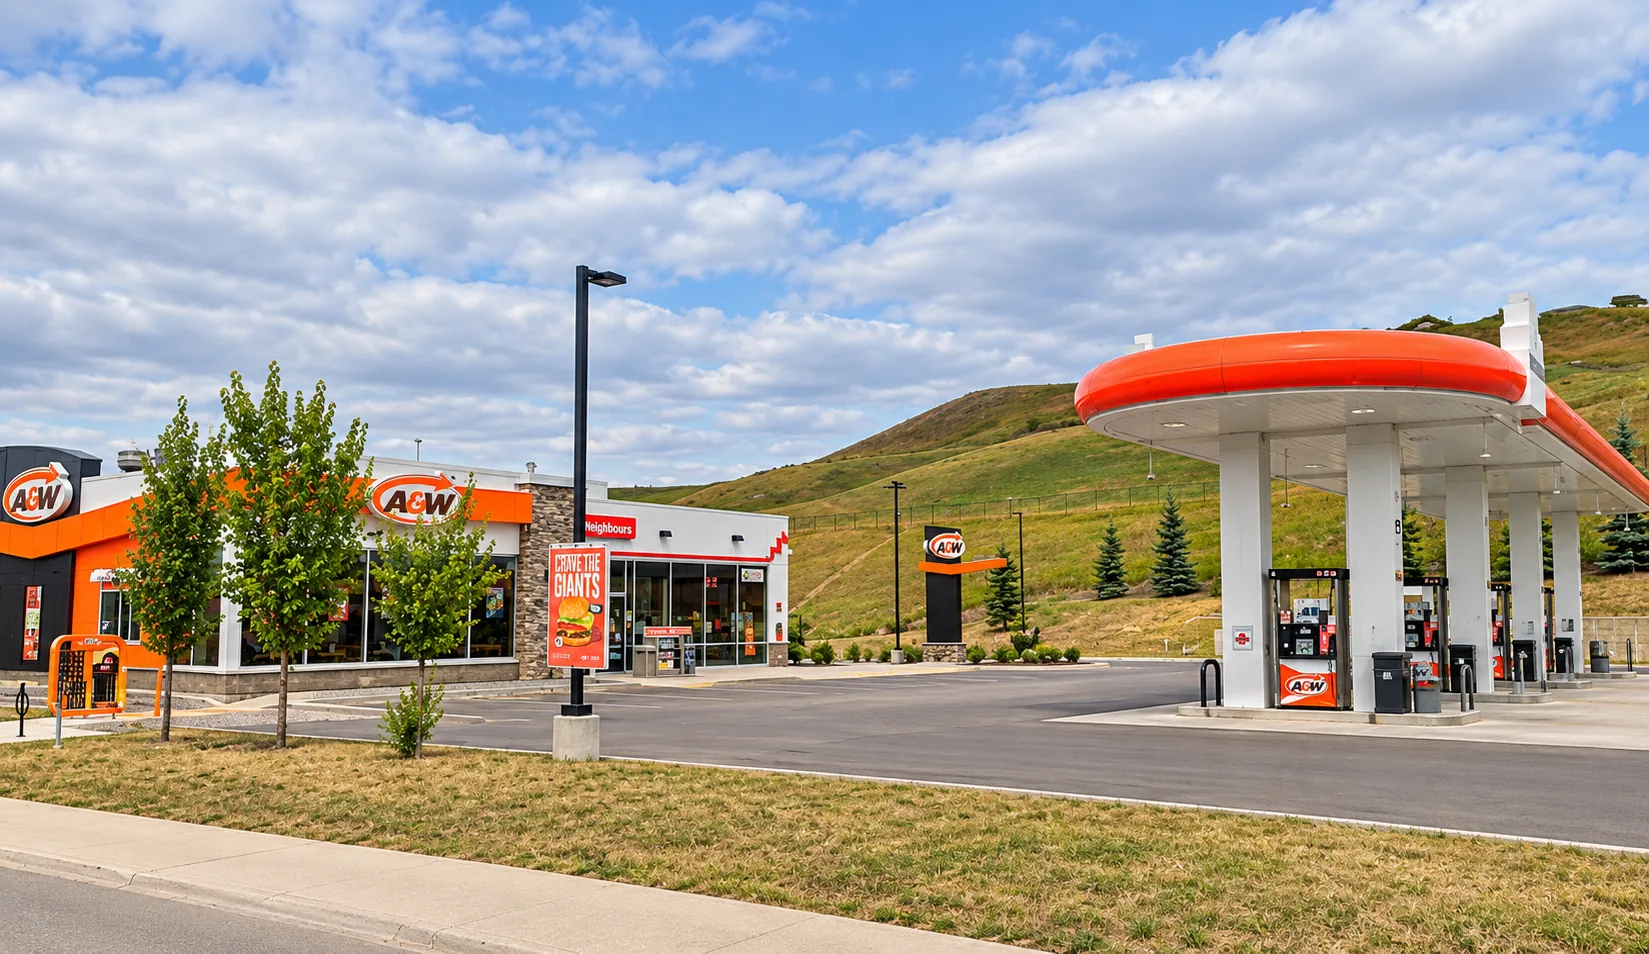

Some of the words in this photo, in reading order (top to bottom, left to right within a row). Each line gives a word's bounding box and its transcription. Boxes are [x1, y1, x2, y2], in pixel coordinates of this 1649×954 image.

[10, 484, 62, 513] A&W
[383, 490, 456, 516] A&W
[585, 521, 633, 536] Neighbours
[936, 541, 963, 554] A&W
[555, 554, 582, 573] CRAVE
[583, 553, 601, 572] THE
[554, 572, 601, 599] GIANTS
[1291, 680, 1326, 692] A&W
